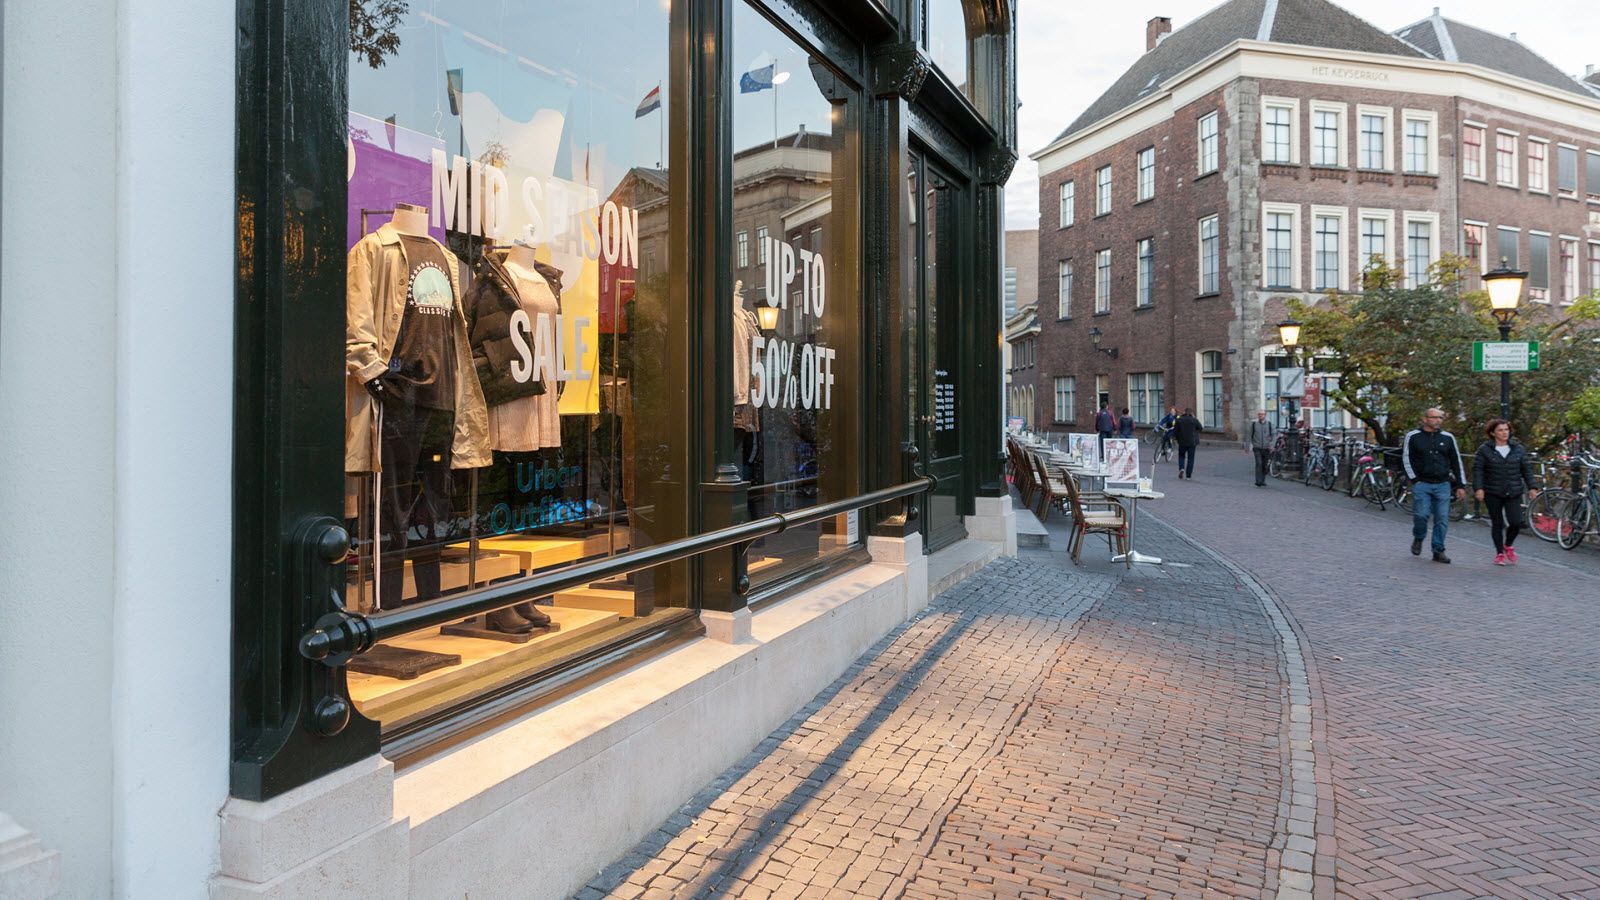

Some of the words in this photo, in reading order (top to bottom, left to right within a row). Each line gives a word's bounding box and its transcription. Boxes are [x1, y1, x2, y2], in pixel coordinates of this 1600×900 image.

[1312, 65, 1328, 77] HET
[432, 147, 508, 242] MID
[522, 176, 639, 270] SEASON
[766, 236, 795, 310] UP
[800, 248, 826, 318] TO
[510, 309, 591, 384] SALE
[751, 336, 797, 410] 50%
[801, 343, 836, 410] OFF
[517, 460, 583, 493] Urban
